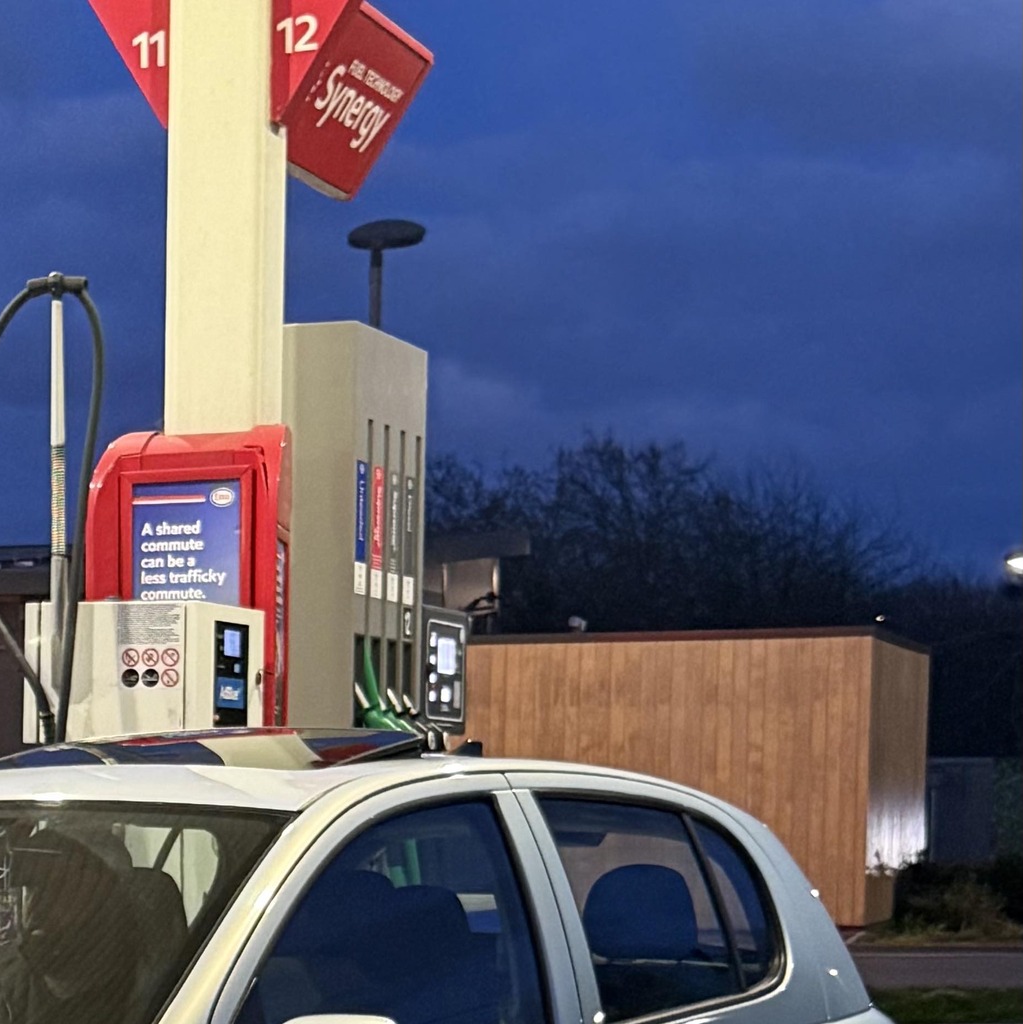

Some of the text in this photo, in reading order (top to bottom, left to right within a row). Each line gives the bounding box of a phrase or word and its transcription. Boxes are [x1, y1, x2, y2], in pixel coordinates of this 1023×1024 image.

[277, 14, 318, 54] 12
[132, 30, 166, 68] 11
[314, 65, 391, 153] Synergy
[141, 520, 201, 536] A shared
[141, 539, 204, 552] commute
[141, 554, 196, 568] can be a
[141, 569, 226, 586] less trafficky
[141, 588, 206, 601] commute.
